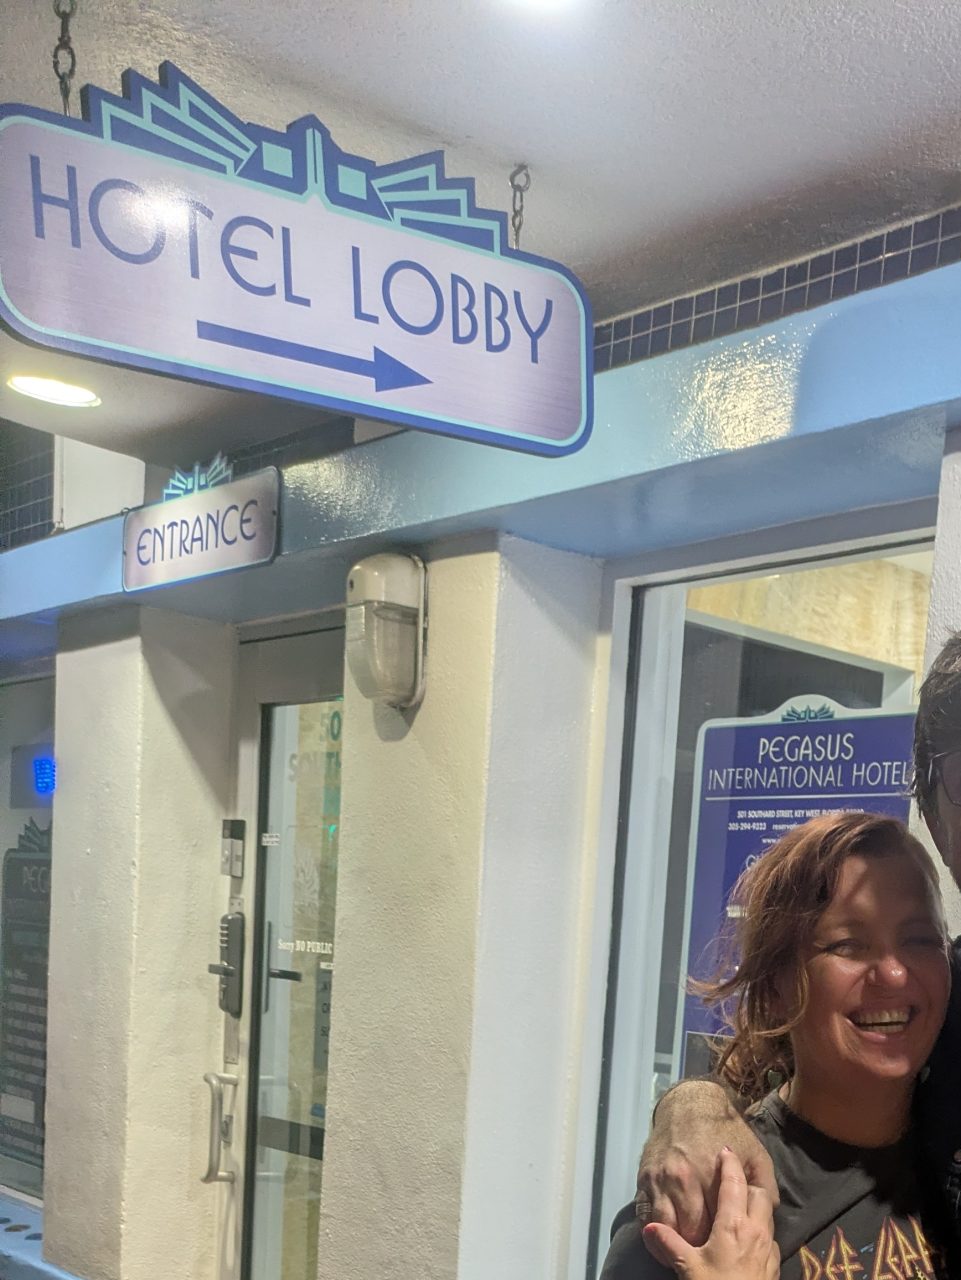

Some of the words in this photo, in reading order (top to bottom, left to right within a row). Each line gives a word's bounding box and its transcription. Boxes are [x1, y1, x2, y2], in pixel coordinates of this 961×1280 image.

[29, 154, 311, 308] HOTEL
[351, 246, 553, 364] LOBBY
[136, 499, 258, 566] ENTRANCE
[758, 733, 854, 764] PEGASUS
[708, 765, 844, 790] INTERNATIONAL
[852, 762, 909, 787] HOTEL
